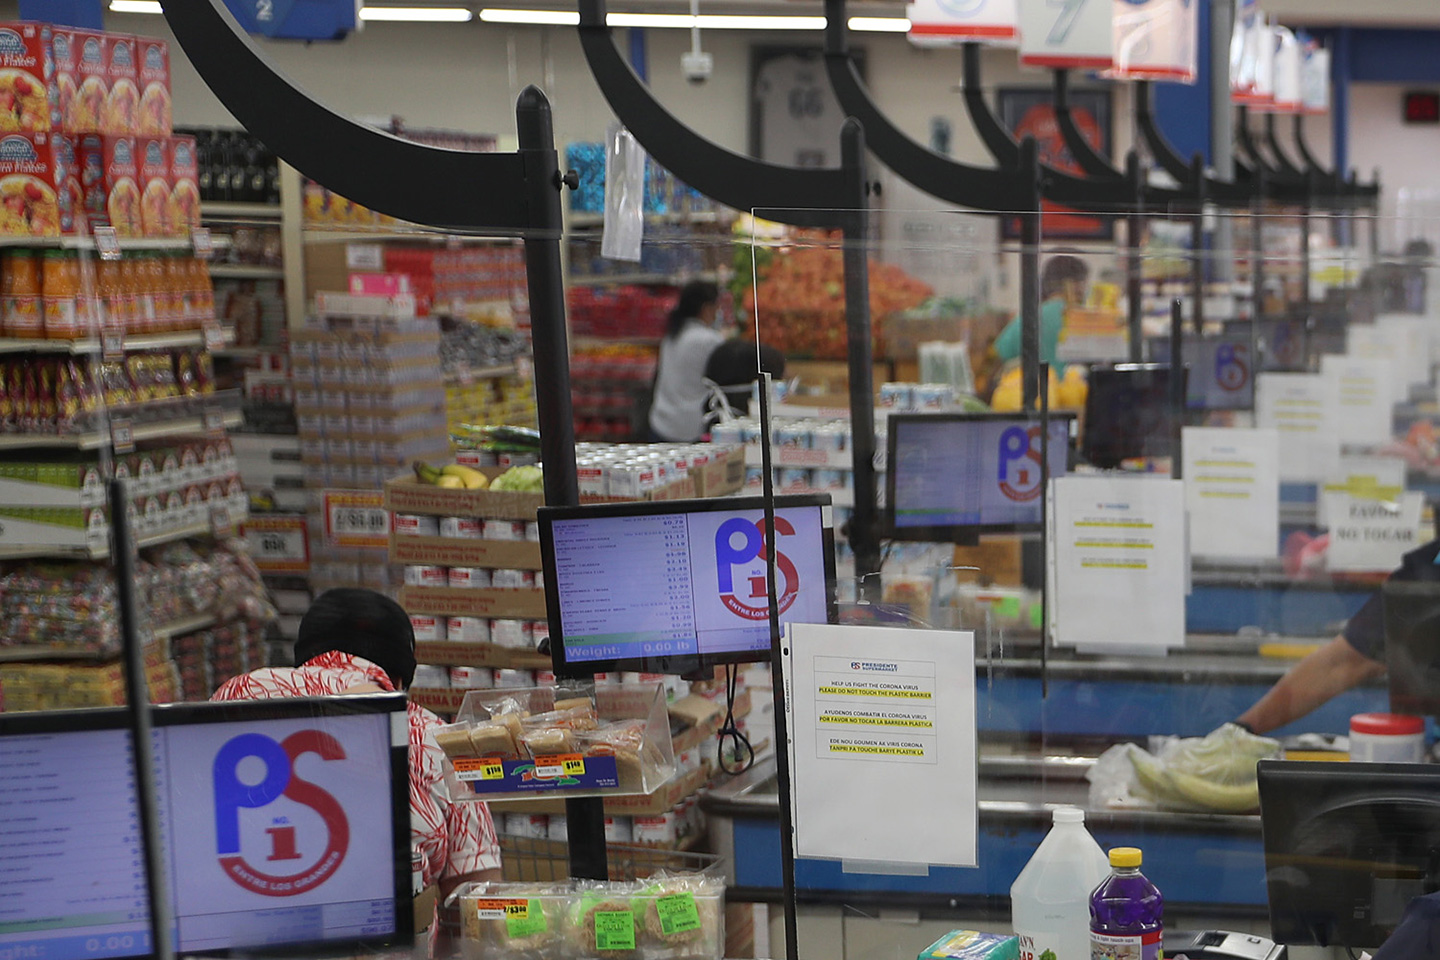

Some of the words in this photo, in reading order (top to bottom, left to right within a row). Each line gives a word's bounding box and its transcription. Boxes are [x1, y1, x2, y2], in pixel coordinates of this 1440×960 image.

[728, 599, 750, 616] ENTRE
[567, 646, 621, 658] Weight:
[643, 642, 671, 652] 0.00
[677, 641, 690, 650] lb
[231, 864, 267, 889] ENTRE
[270, 881, 292, 891] LOS
[294, 851, 341, 888] GRANDES
[86, 935, 133, 952] 0.00
